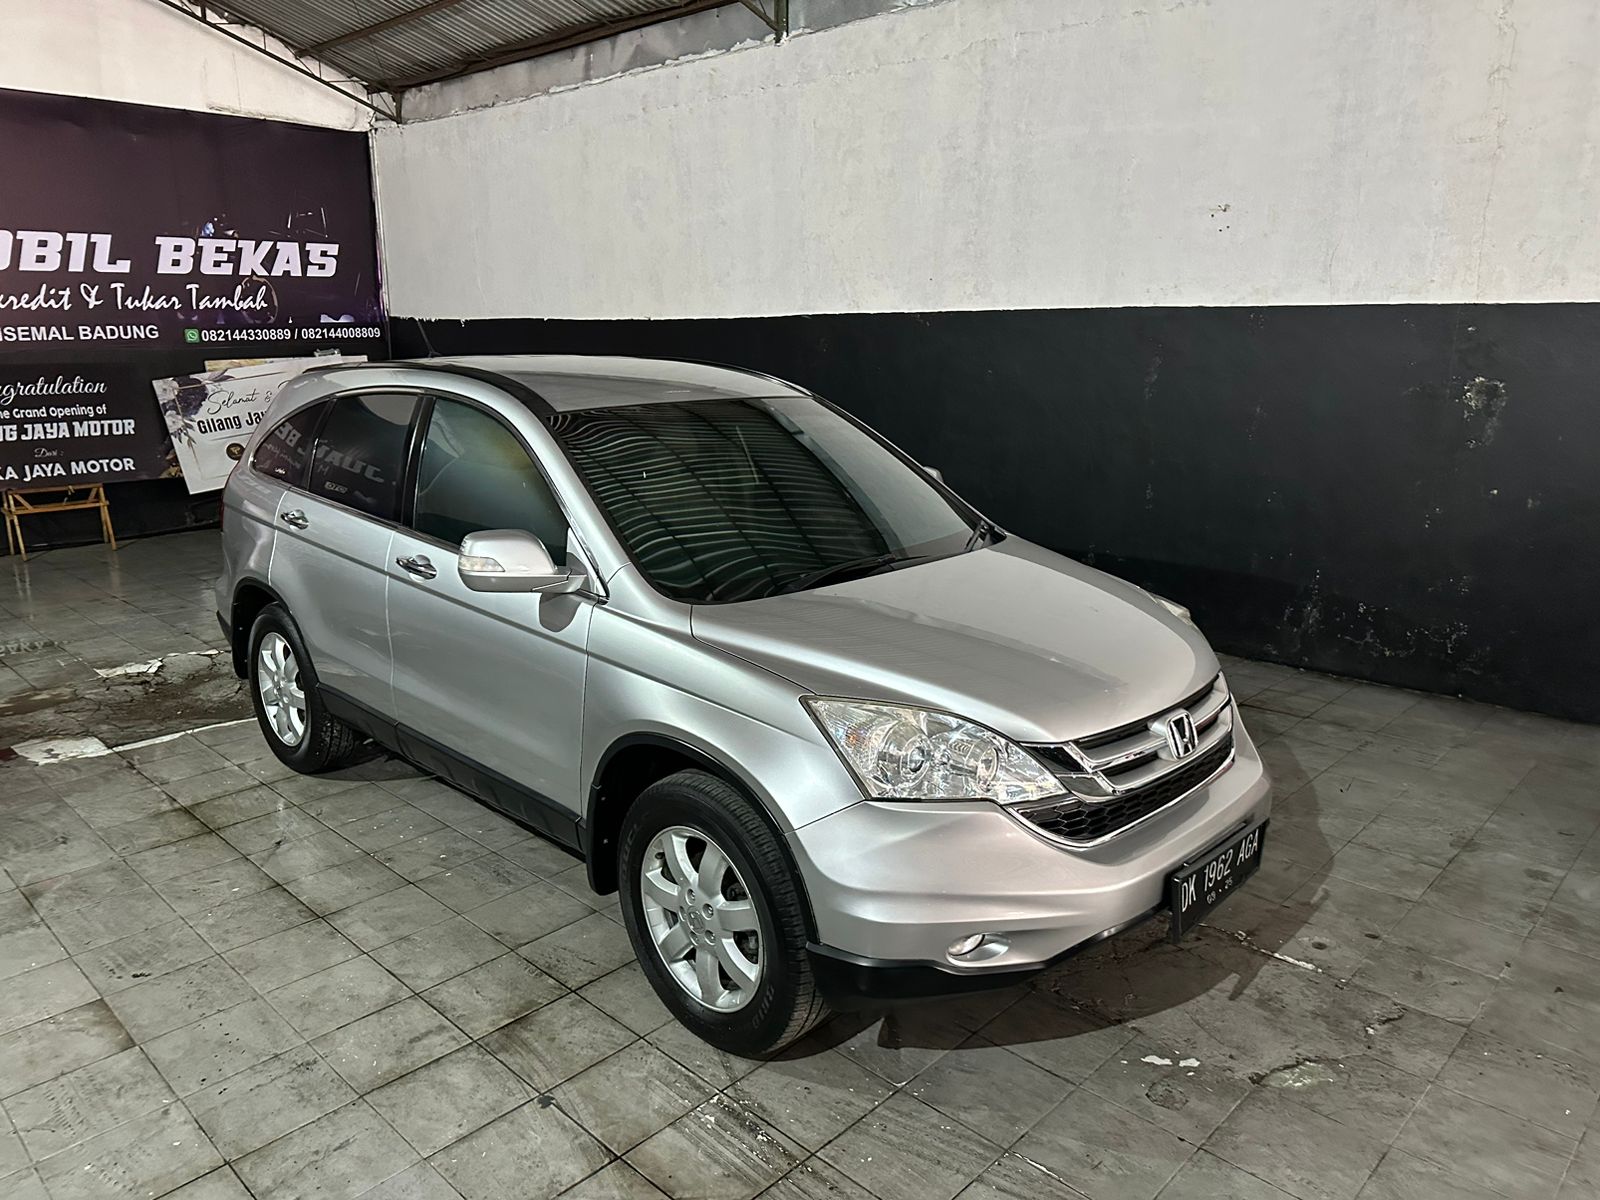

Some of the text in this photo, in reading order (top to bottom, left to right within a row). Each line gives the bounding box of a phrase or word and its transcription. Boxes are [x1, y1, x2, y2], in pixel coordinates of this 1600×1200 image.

[155, 236, 340, 278] BEKAS
[80, 283, 103, 309] &
[110, 282, 182, 311] Tukar
[186, 283, 268, 311] Tambah
[0, 325, 159, 341] SEMAL BADUNG
[201, 328, 291, 341] 082144330889
[301, 327, 381, 339] 082144008809
[0, 375, 107, 406] gratulation
[207, 388, 260, 415] Selamat
[12, 406, 47, 418] Grand
[49, 404, 94, 419] Opening
[96, 403, 107, 415] of
[21, 422, 70, 440] JAYA
[72, 419, 135, 437] MOTOR
[23, 463, 66, 481] JAYA
[70, 457, 136, 475] MOTOR
[1182, 828, 1259, 912] DK 1962 AGA
